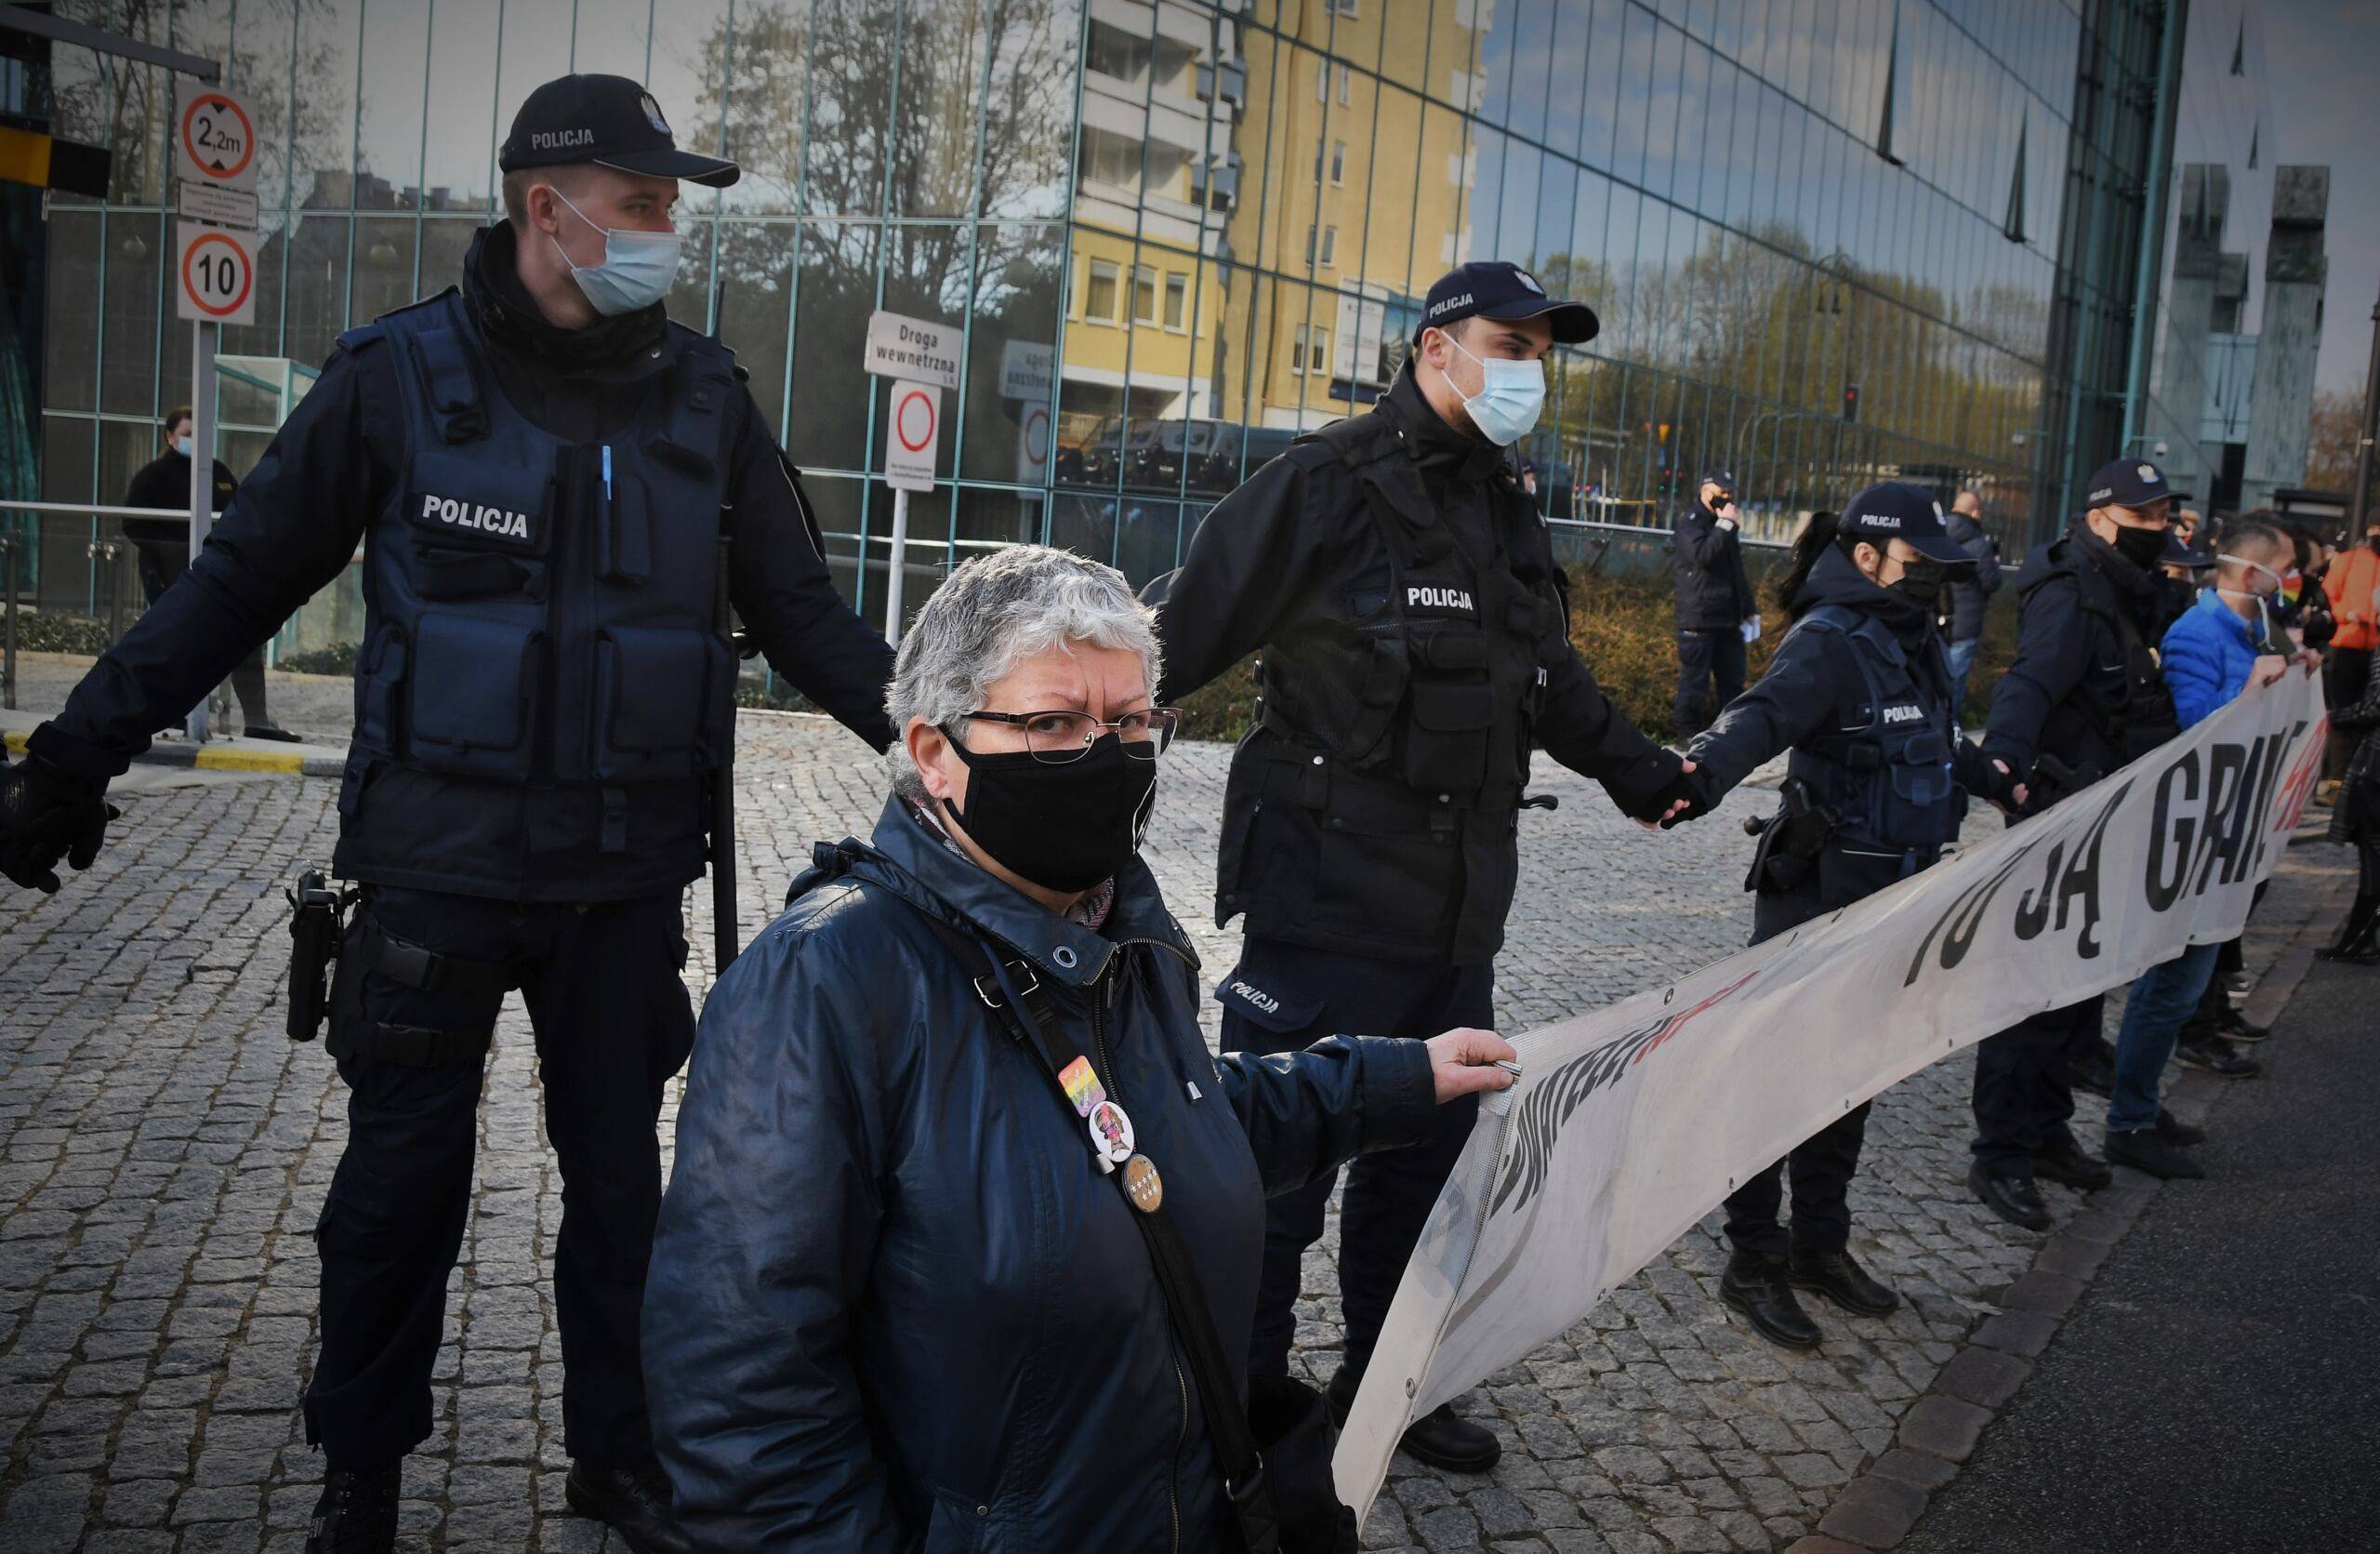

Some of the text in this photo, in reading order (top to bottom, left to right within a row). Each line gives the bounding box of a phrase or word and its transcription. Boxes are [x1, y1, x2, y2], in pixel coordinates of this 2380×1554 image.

[198, 117, 240, 153] 2,2m
[532, 129, 594, 150] POLICJA
[198, 254, 235, 296] 10
[1429, 293, 1474, 320] POLICJA
[899, 324, 939, 351] Droga
[422, 494, 528, 538] POLICJA
[1860, 514, 1901, 528] POLICJA
[1408, 587, 1474, 611] POLICJA
[1230, 981, 1279, 1014] POLICJA
